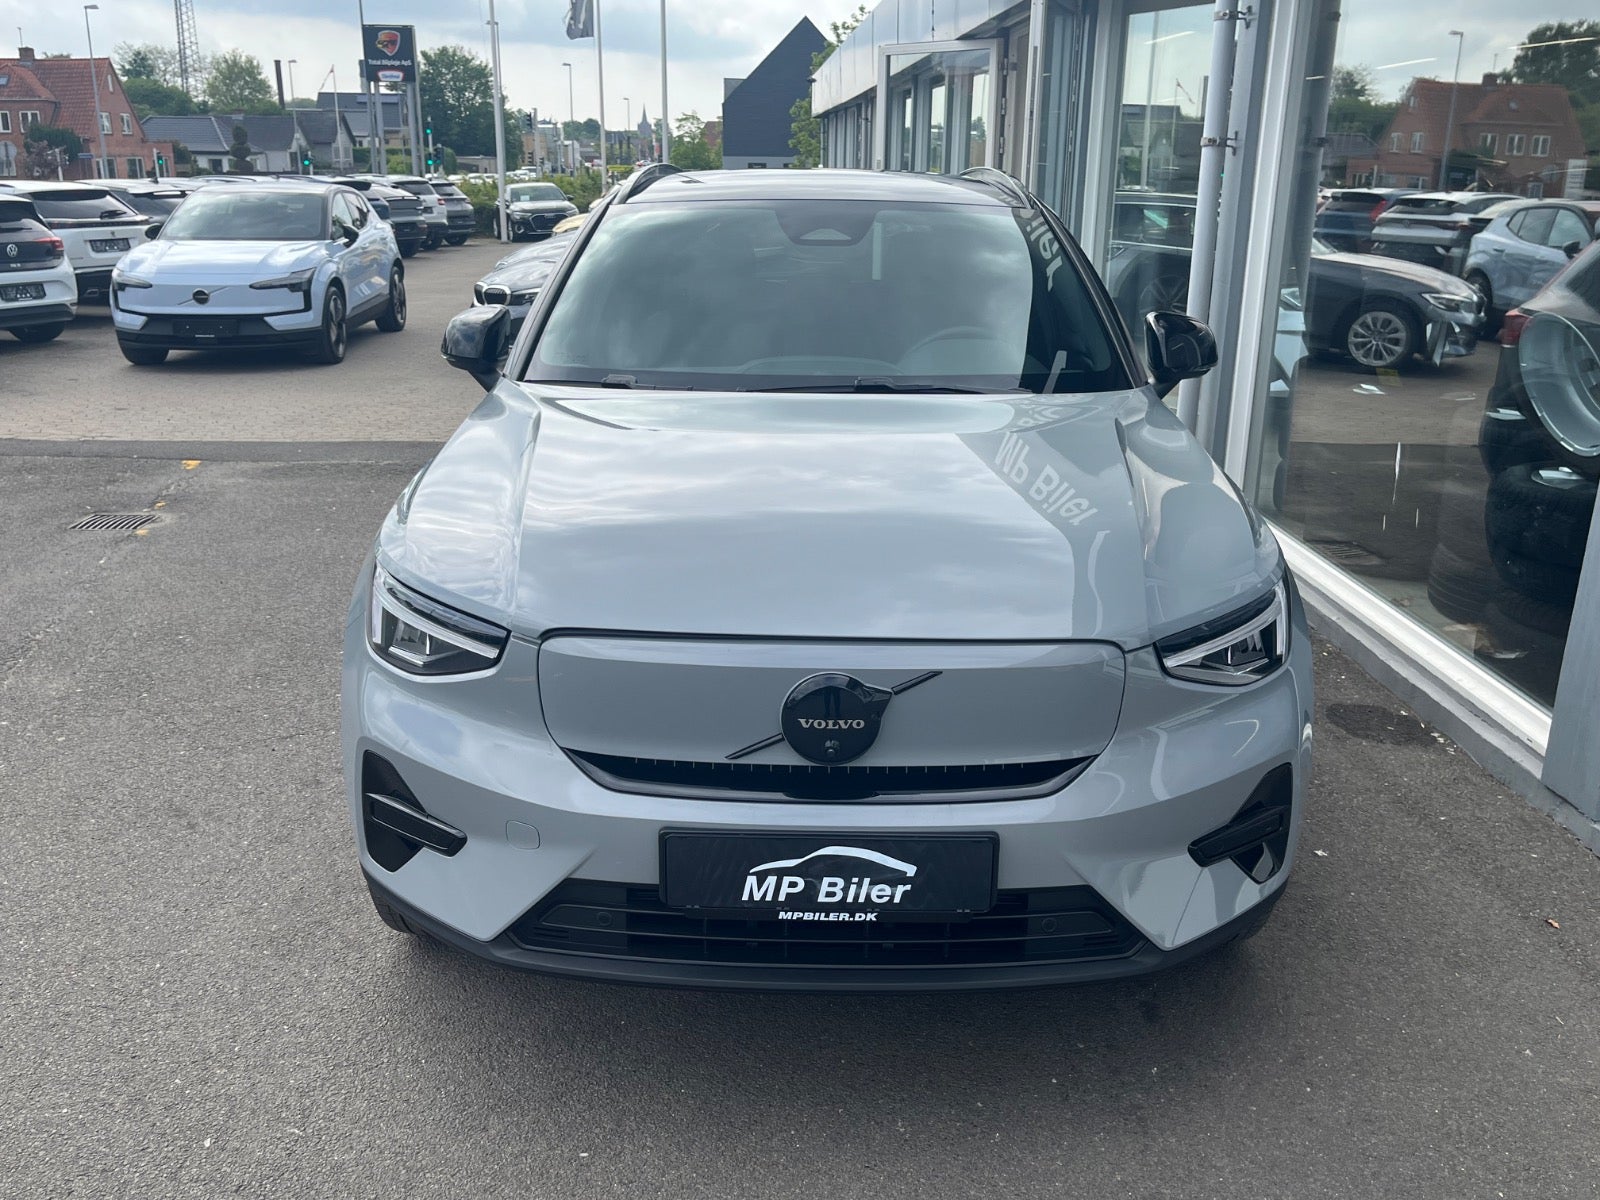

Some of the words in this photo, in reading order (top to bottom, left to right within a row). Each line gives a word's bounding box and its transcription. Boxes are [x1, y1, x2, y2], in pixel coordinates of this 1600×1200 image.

[797, 718, 865, 729] VOLVO
[741, 875, 805, 901] MP
[817, 876, 912, 904] Biler
[778, 911, 878, 921] MPBILER.DK
